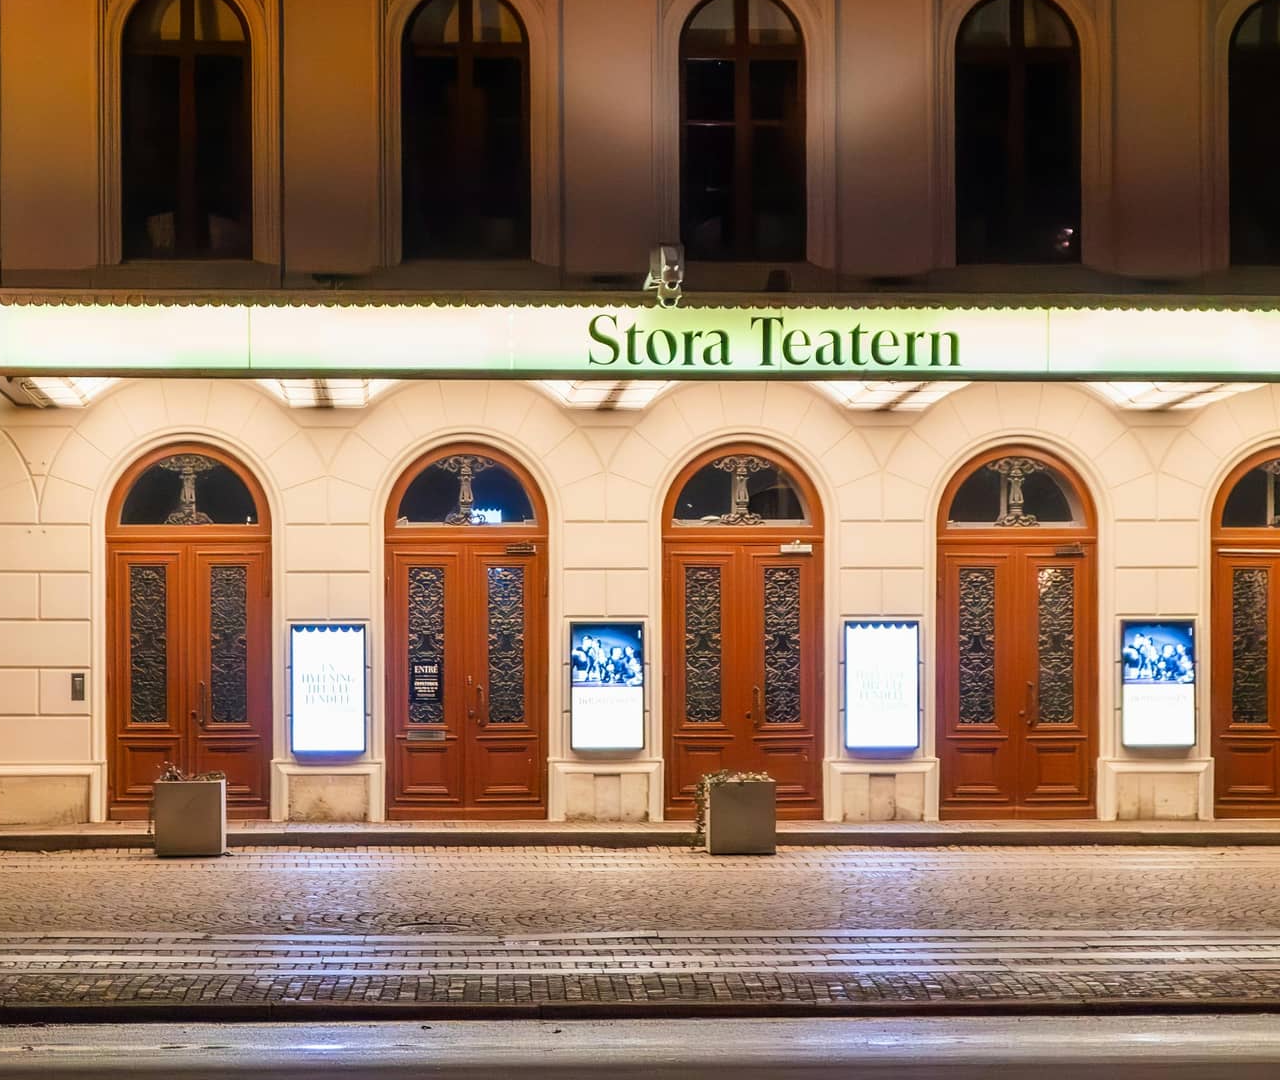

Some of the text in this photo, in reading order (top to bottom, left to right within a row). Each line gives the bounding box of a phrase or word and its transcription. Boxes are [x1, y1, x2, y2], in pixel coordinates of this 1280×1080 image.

[588, 314, 962, 367] Stora Teatern
[414, 663, 439, 674] ENTRÉ
